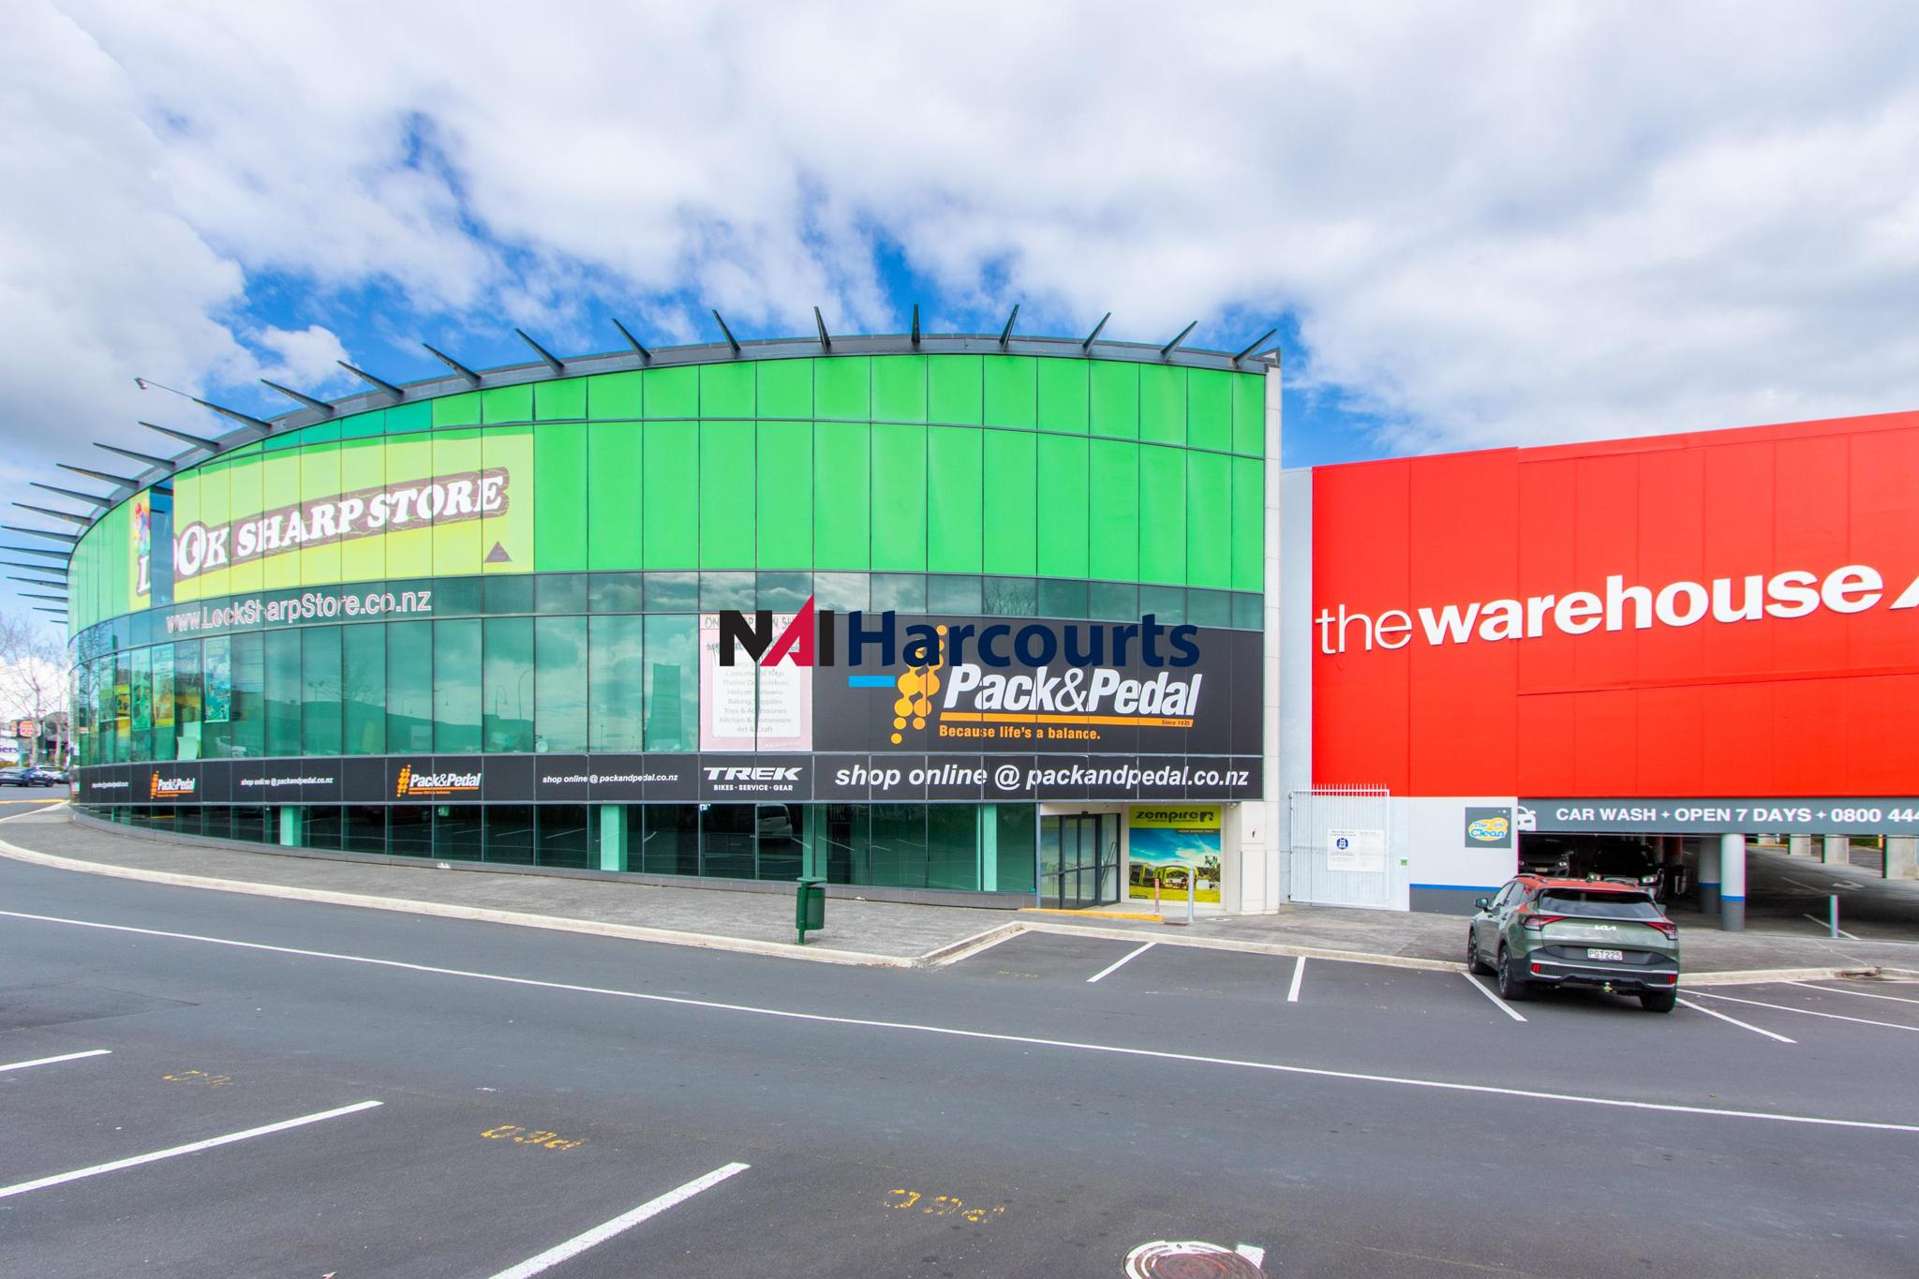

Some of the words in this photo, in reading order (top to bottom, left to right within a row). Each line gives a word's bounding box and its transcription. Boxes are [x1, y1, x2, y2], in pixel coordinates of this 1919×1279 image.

[136, 524, 231, 593] LOK
[237, 498, 364, 558] SHARP
[366, 475, 505, 528] STORE
[1417, 564, 1884, 646] warehouse
[943, 663, 1202, 717] Pack&Pedal
[939, 724, 996, 739] Because
[999, 725, 1032, 739] life's
[1036, 728, 1044, 739] a
[1047, 727, 1101, 740] balance.
[409, 773, 482, 788] Pack&Pedal
[542, 776, 562, 785] shop
[563, 775, 588, 783] online
[589, 774, 598, 785] @
[599, 773, 679, 783] packandpedal.co.nz
[703, 767, 803, 781] TREK
[834, 764, 900, 790] shop
[908, 763, 988, 786] online
[994, 764, 1020, 790] @
[1025, 764, 1249, 790] packandpedal.co.nz
[1556, 807, 1595, 822] CAR
[1599, 807, 1657, 822] WASH
[1674, 807, 1731, 822] OPEN
[1735, 808, 1748, 822] 7
[1753, 808, 1812, 823] DAYS
[1831, 808, 1881, 822] 0800
